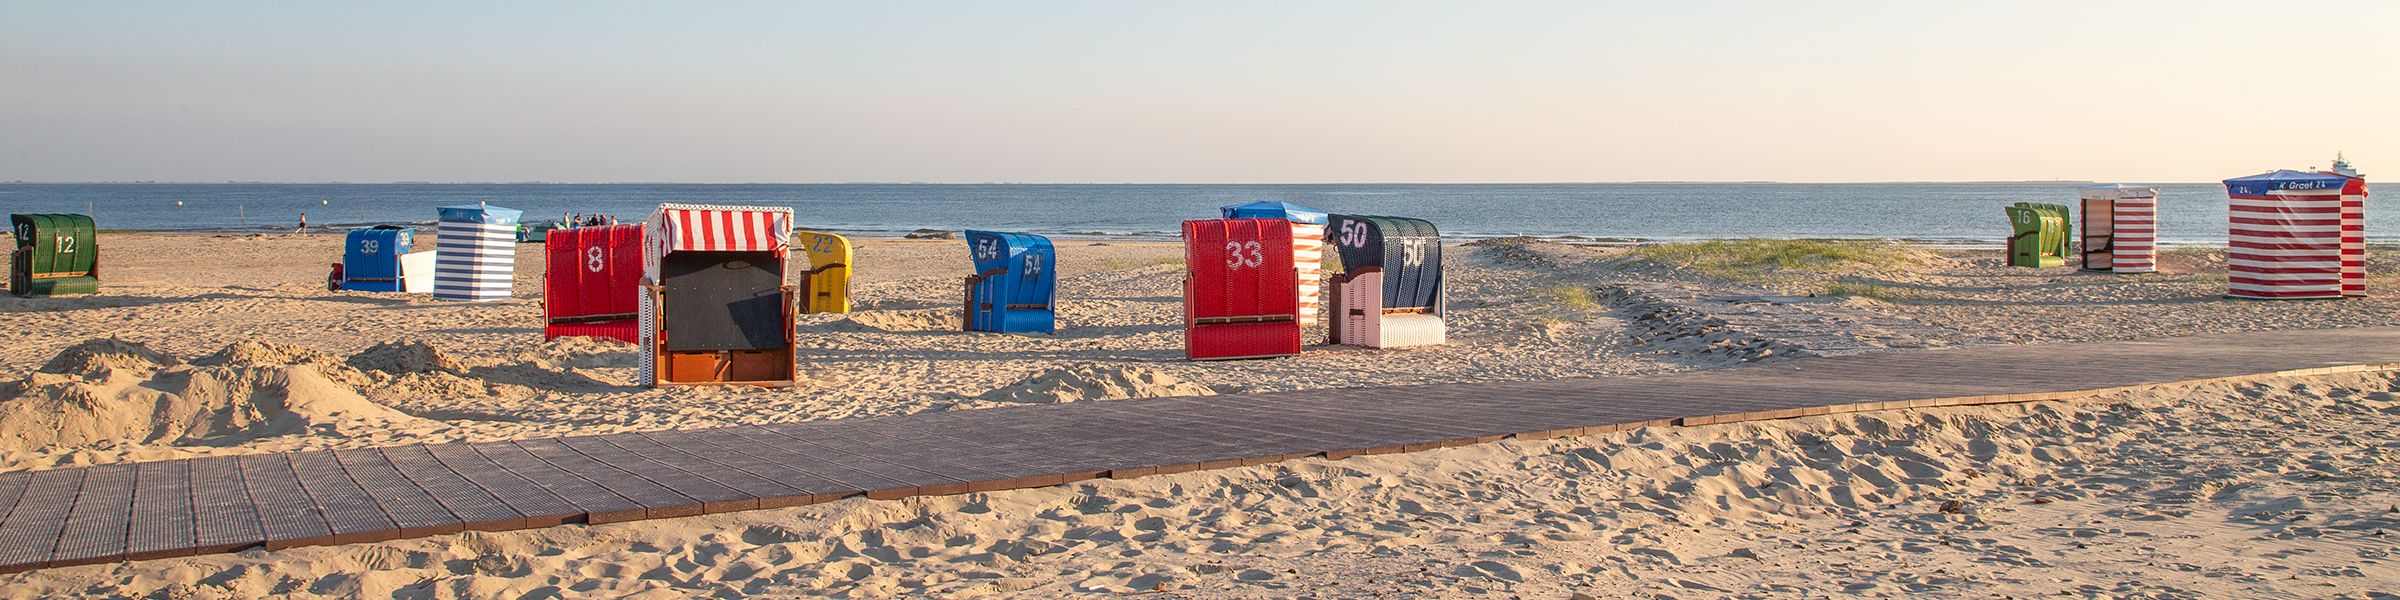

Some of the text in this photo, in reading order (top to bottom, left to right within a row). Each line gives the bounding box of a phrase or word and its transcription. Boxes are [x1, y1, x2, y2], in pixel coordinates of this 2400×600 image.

[2017, 210, 2030, 225] 16
[18, 222, 29, 241] 12
[400, 231, 410, 247] 39
[1341, 219, 1368, 248] 50
[56, 235, 75, 254] 12
[360, 239, 379, 254] 39
[813, 234, 833, 253] 22
[978, 238, 998, 259] 54
[1403, 239, 1425, 267] 50
[588, 245, 604, 273] 8
[1024, 254, 1041, 275] 54
[1226, 240, 1263, 271] 33
